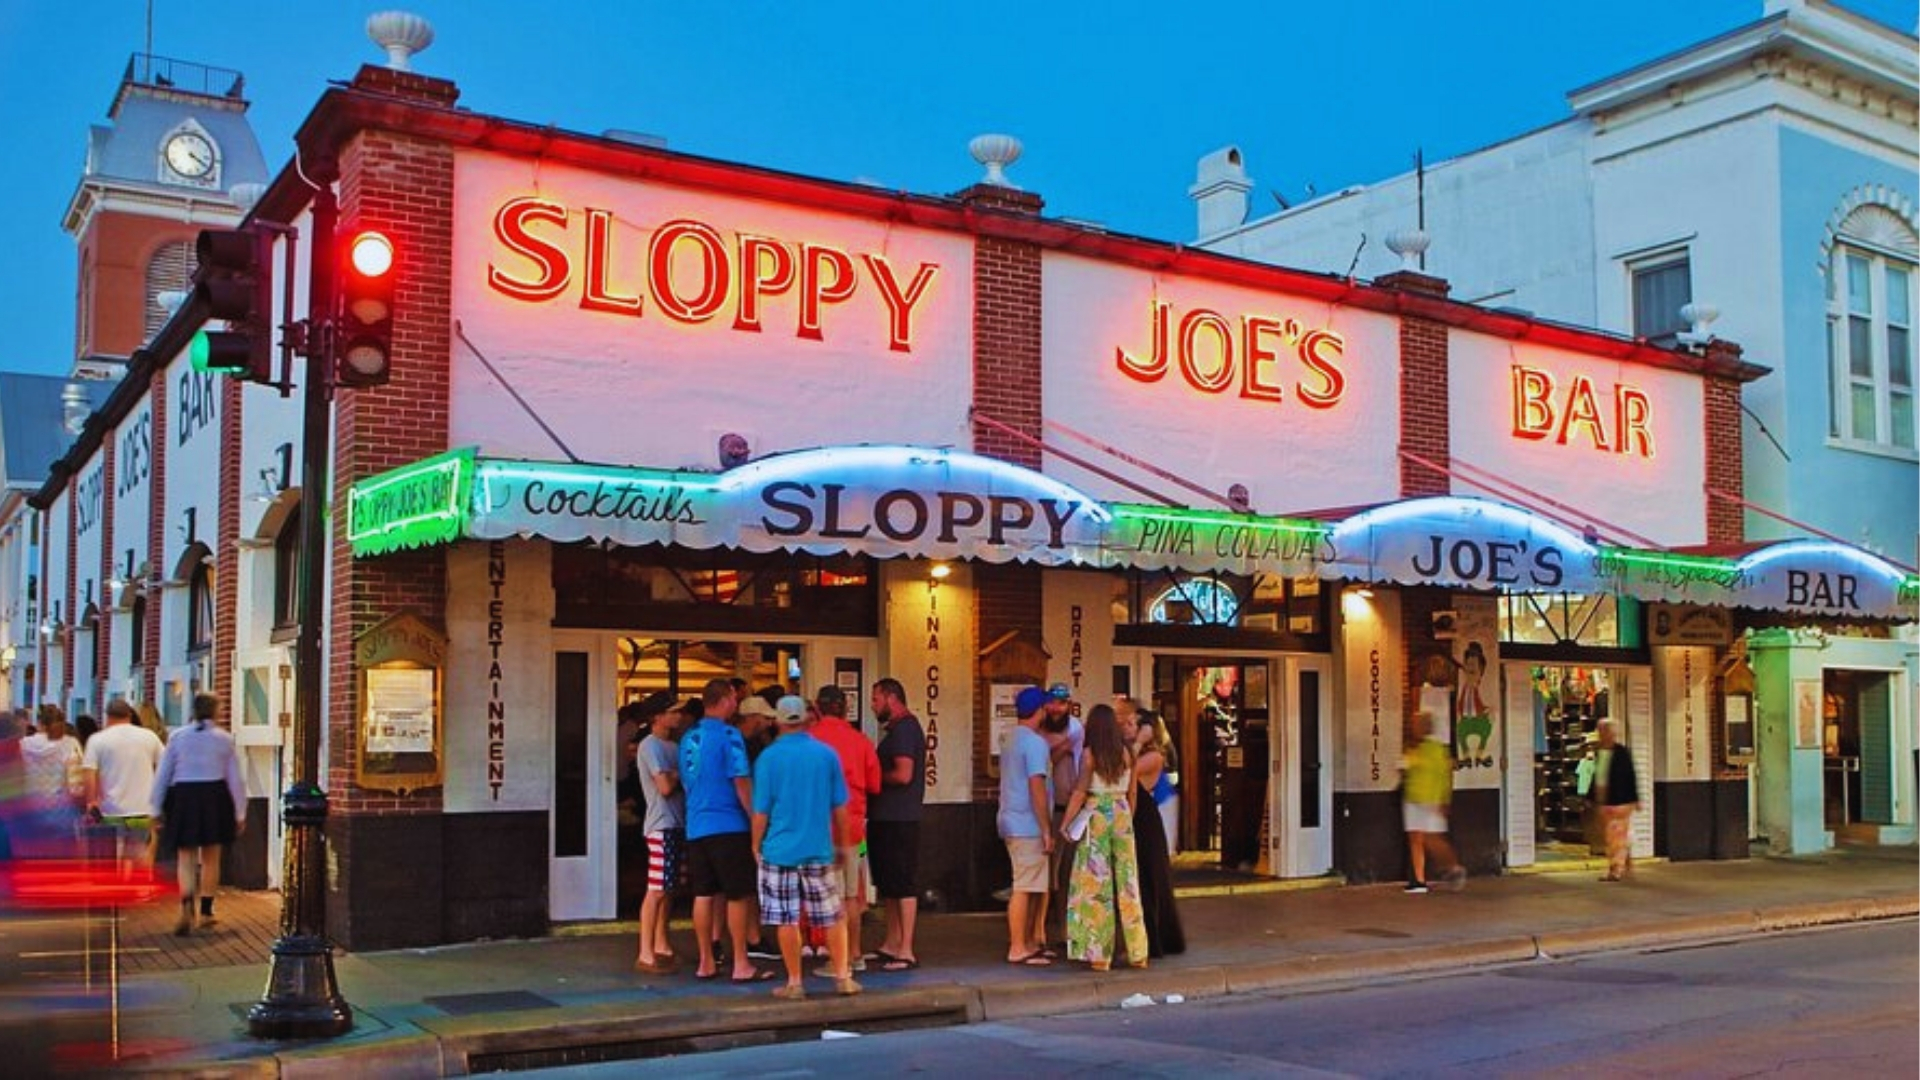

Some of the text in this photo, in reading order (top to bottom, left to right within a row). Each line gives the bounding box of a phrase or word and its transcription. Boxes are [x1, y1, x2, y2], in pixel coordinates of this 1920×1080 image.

[487, 196, 939, 352] SLOPPY
[1116, 301, 1346, 410] JOE'S
[1511, 364, 1656, 458] BAR
[761, 481, 1081, 549] SLOPPY
[1137, 519, 1195, 556] PINA
[1412, 535, 1563, 586] JOE'S
[1787, 570, 1861, 610] BAR
[488, 541, 505, 801] ENTERTAINMENT
[926, 579, 940, 787] PINA COLADAS
[1071, 605, 1082, 688] DRAFT
[1370, 650, 1380, 781] COCKTAILS
